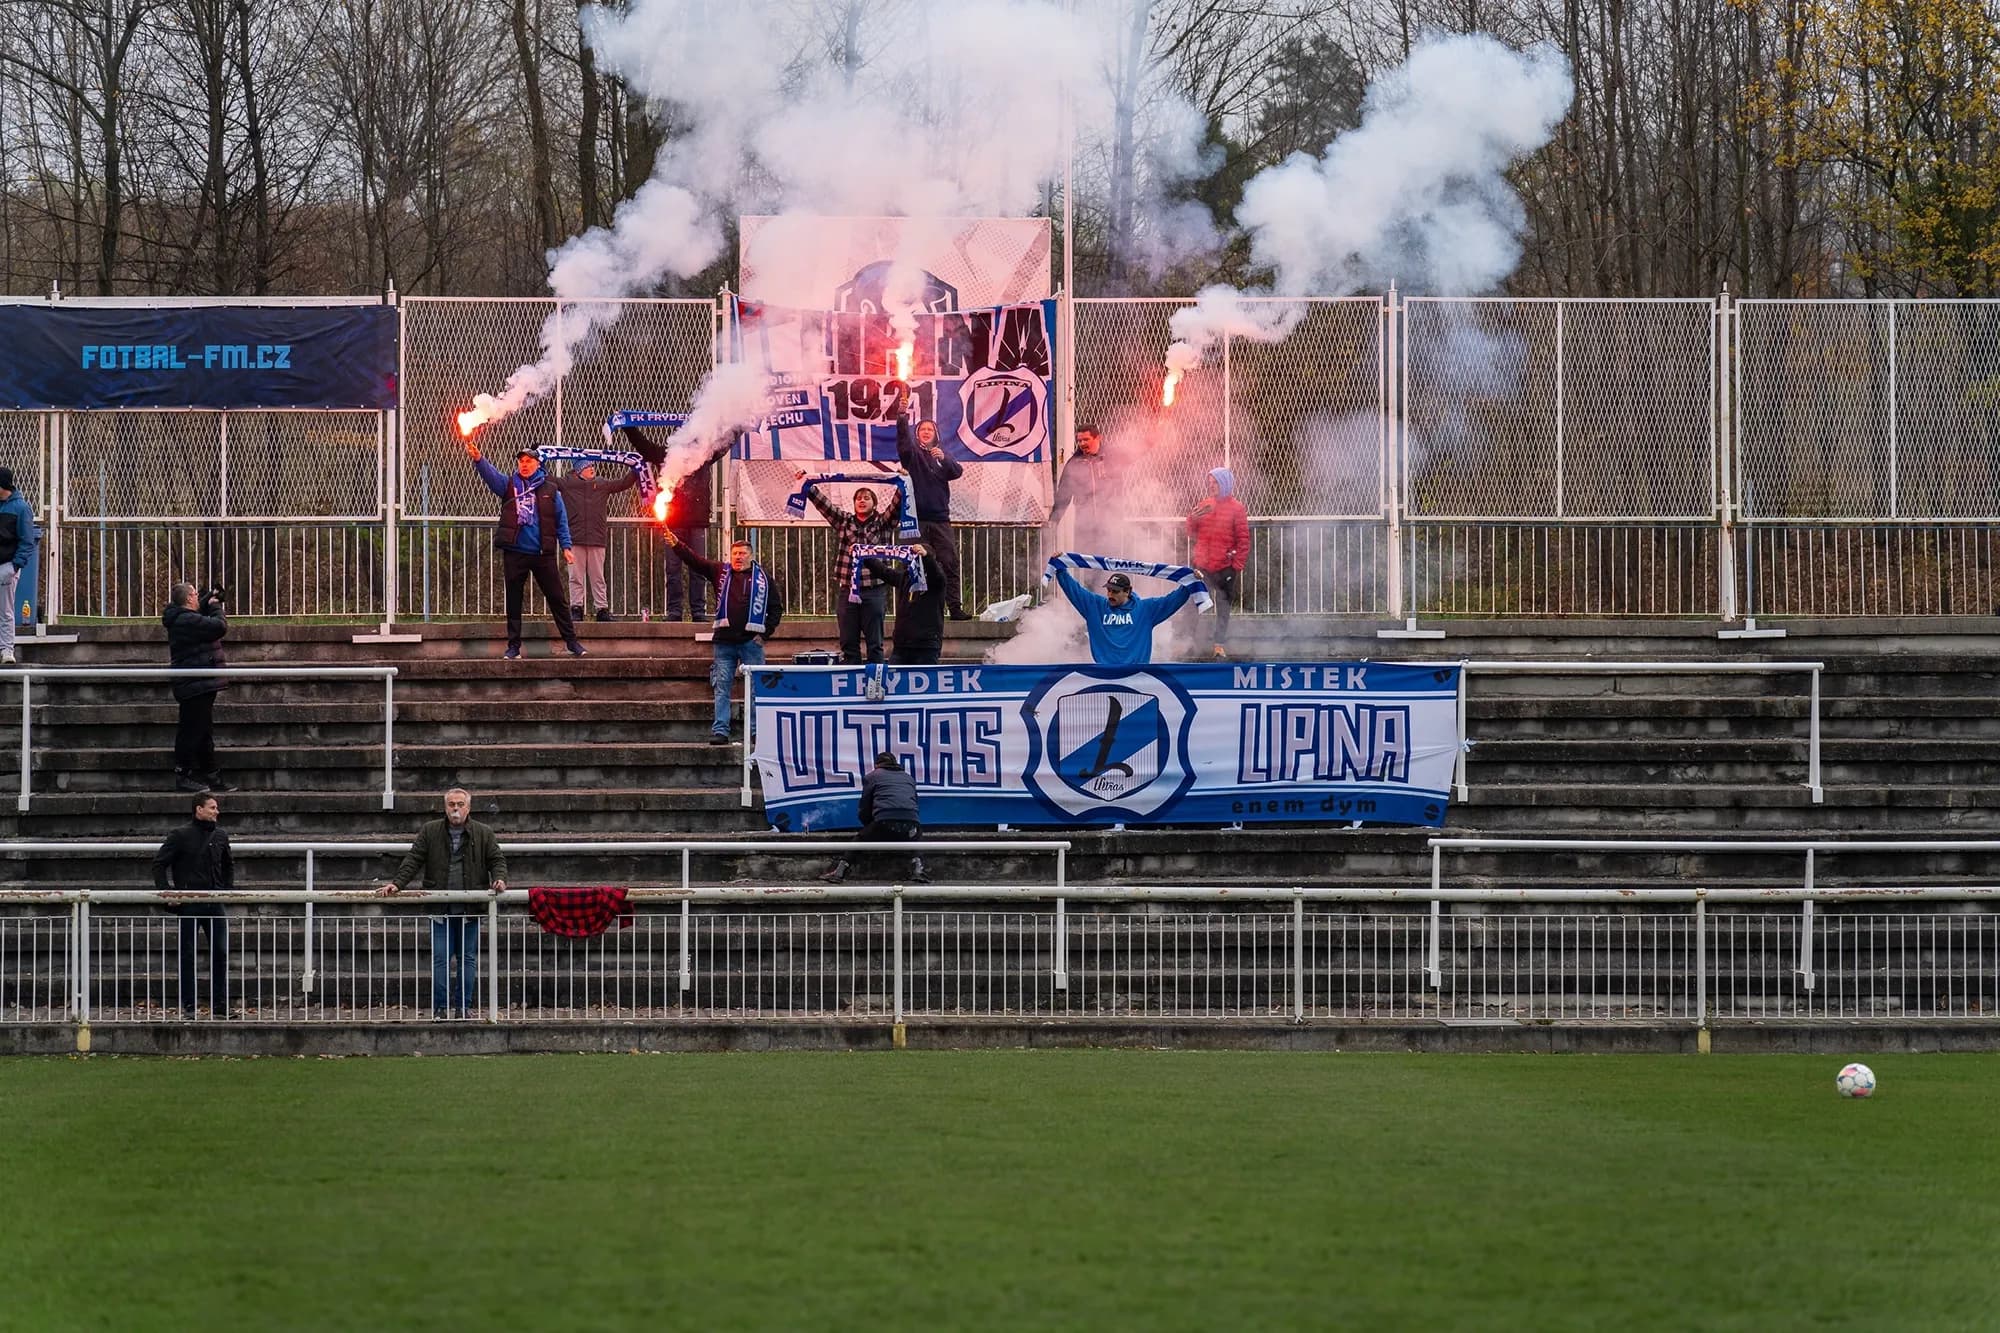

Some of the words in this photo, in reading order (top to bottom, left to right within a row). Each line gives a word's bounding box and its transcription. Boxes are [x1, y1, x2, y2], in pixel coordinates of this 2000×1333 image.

[81, 344, 291, 370] FOTBAL-FM.CZ
[976, 380, 1031, 389] LIPINA
[827, 379, 933, 421] 1921
[630, 414, 645, 422] FK
[1102, 612, 1134, 625] LIPINA
[776, 707, 1003, 792] ULTRAS
[1237, 703, 1412, 785] LIPINA
[1093, 776, 1124, 791] Ultras
[1232, 799, 1305, 815] enem
[1320, 796, 1378, 817] dym
